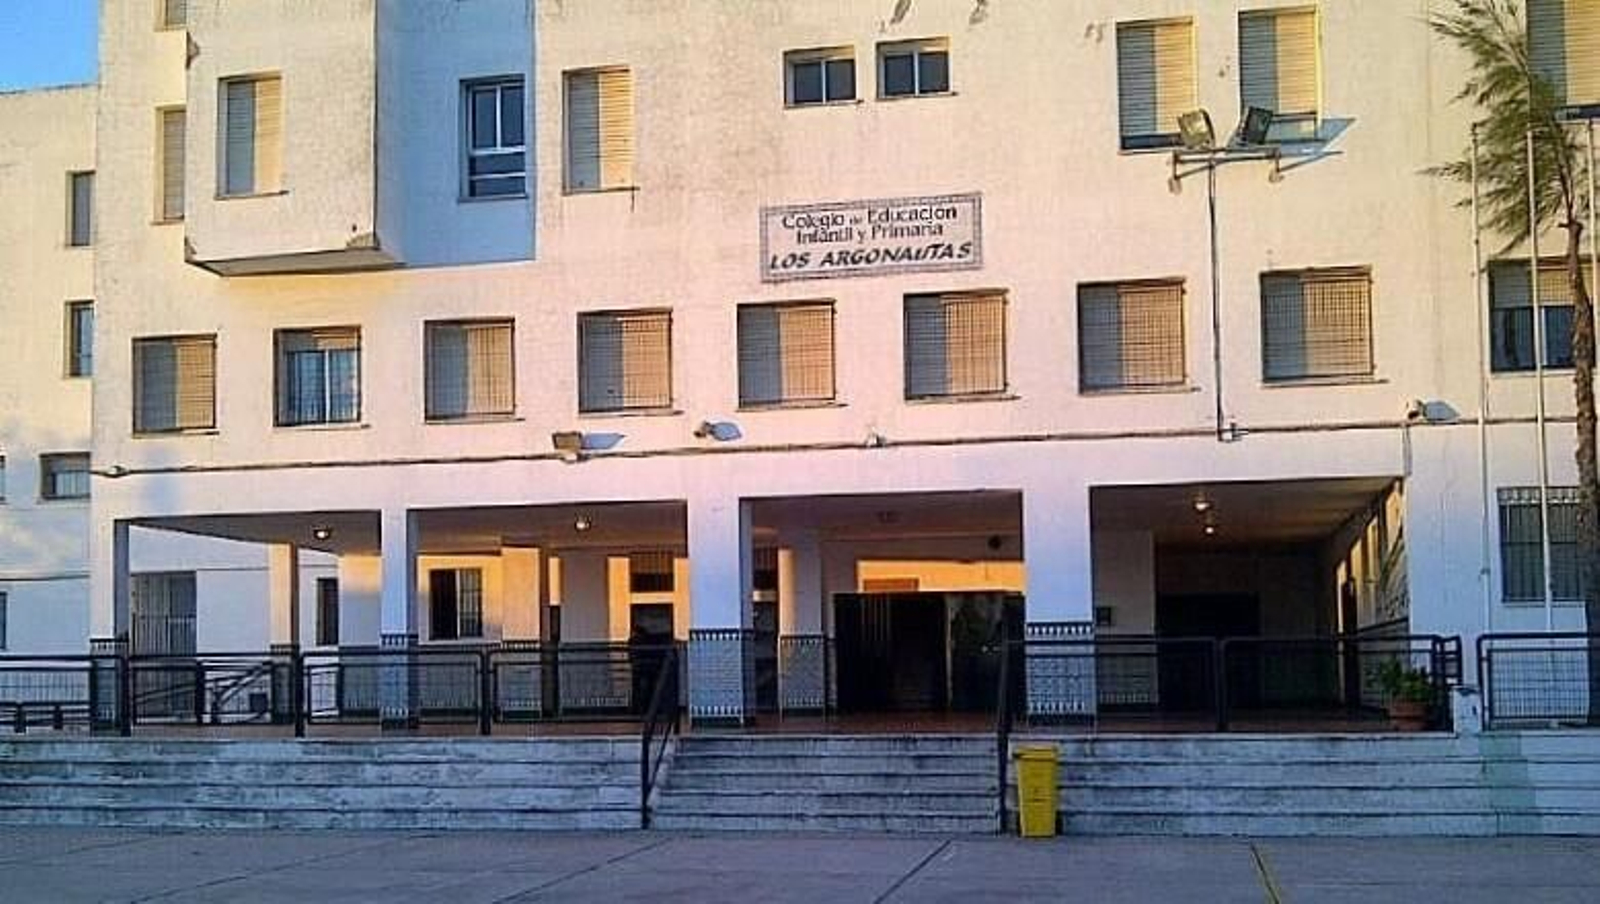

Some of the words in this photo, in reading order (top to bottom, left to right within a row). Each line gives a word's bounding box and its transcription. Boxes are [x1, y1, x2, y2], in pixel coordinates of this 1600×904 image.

[872, 221, 943, 239] Primaria
[770, 252, 811, 270] LOS
[820, 241, 972, 267] ARGONAUTAS
